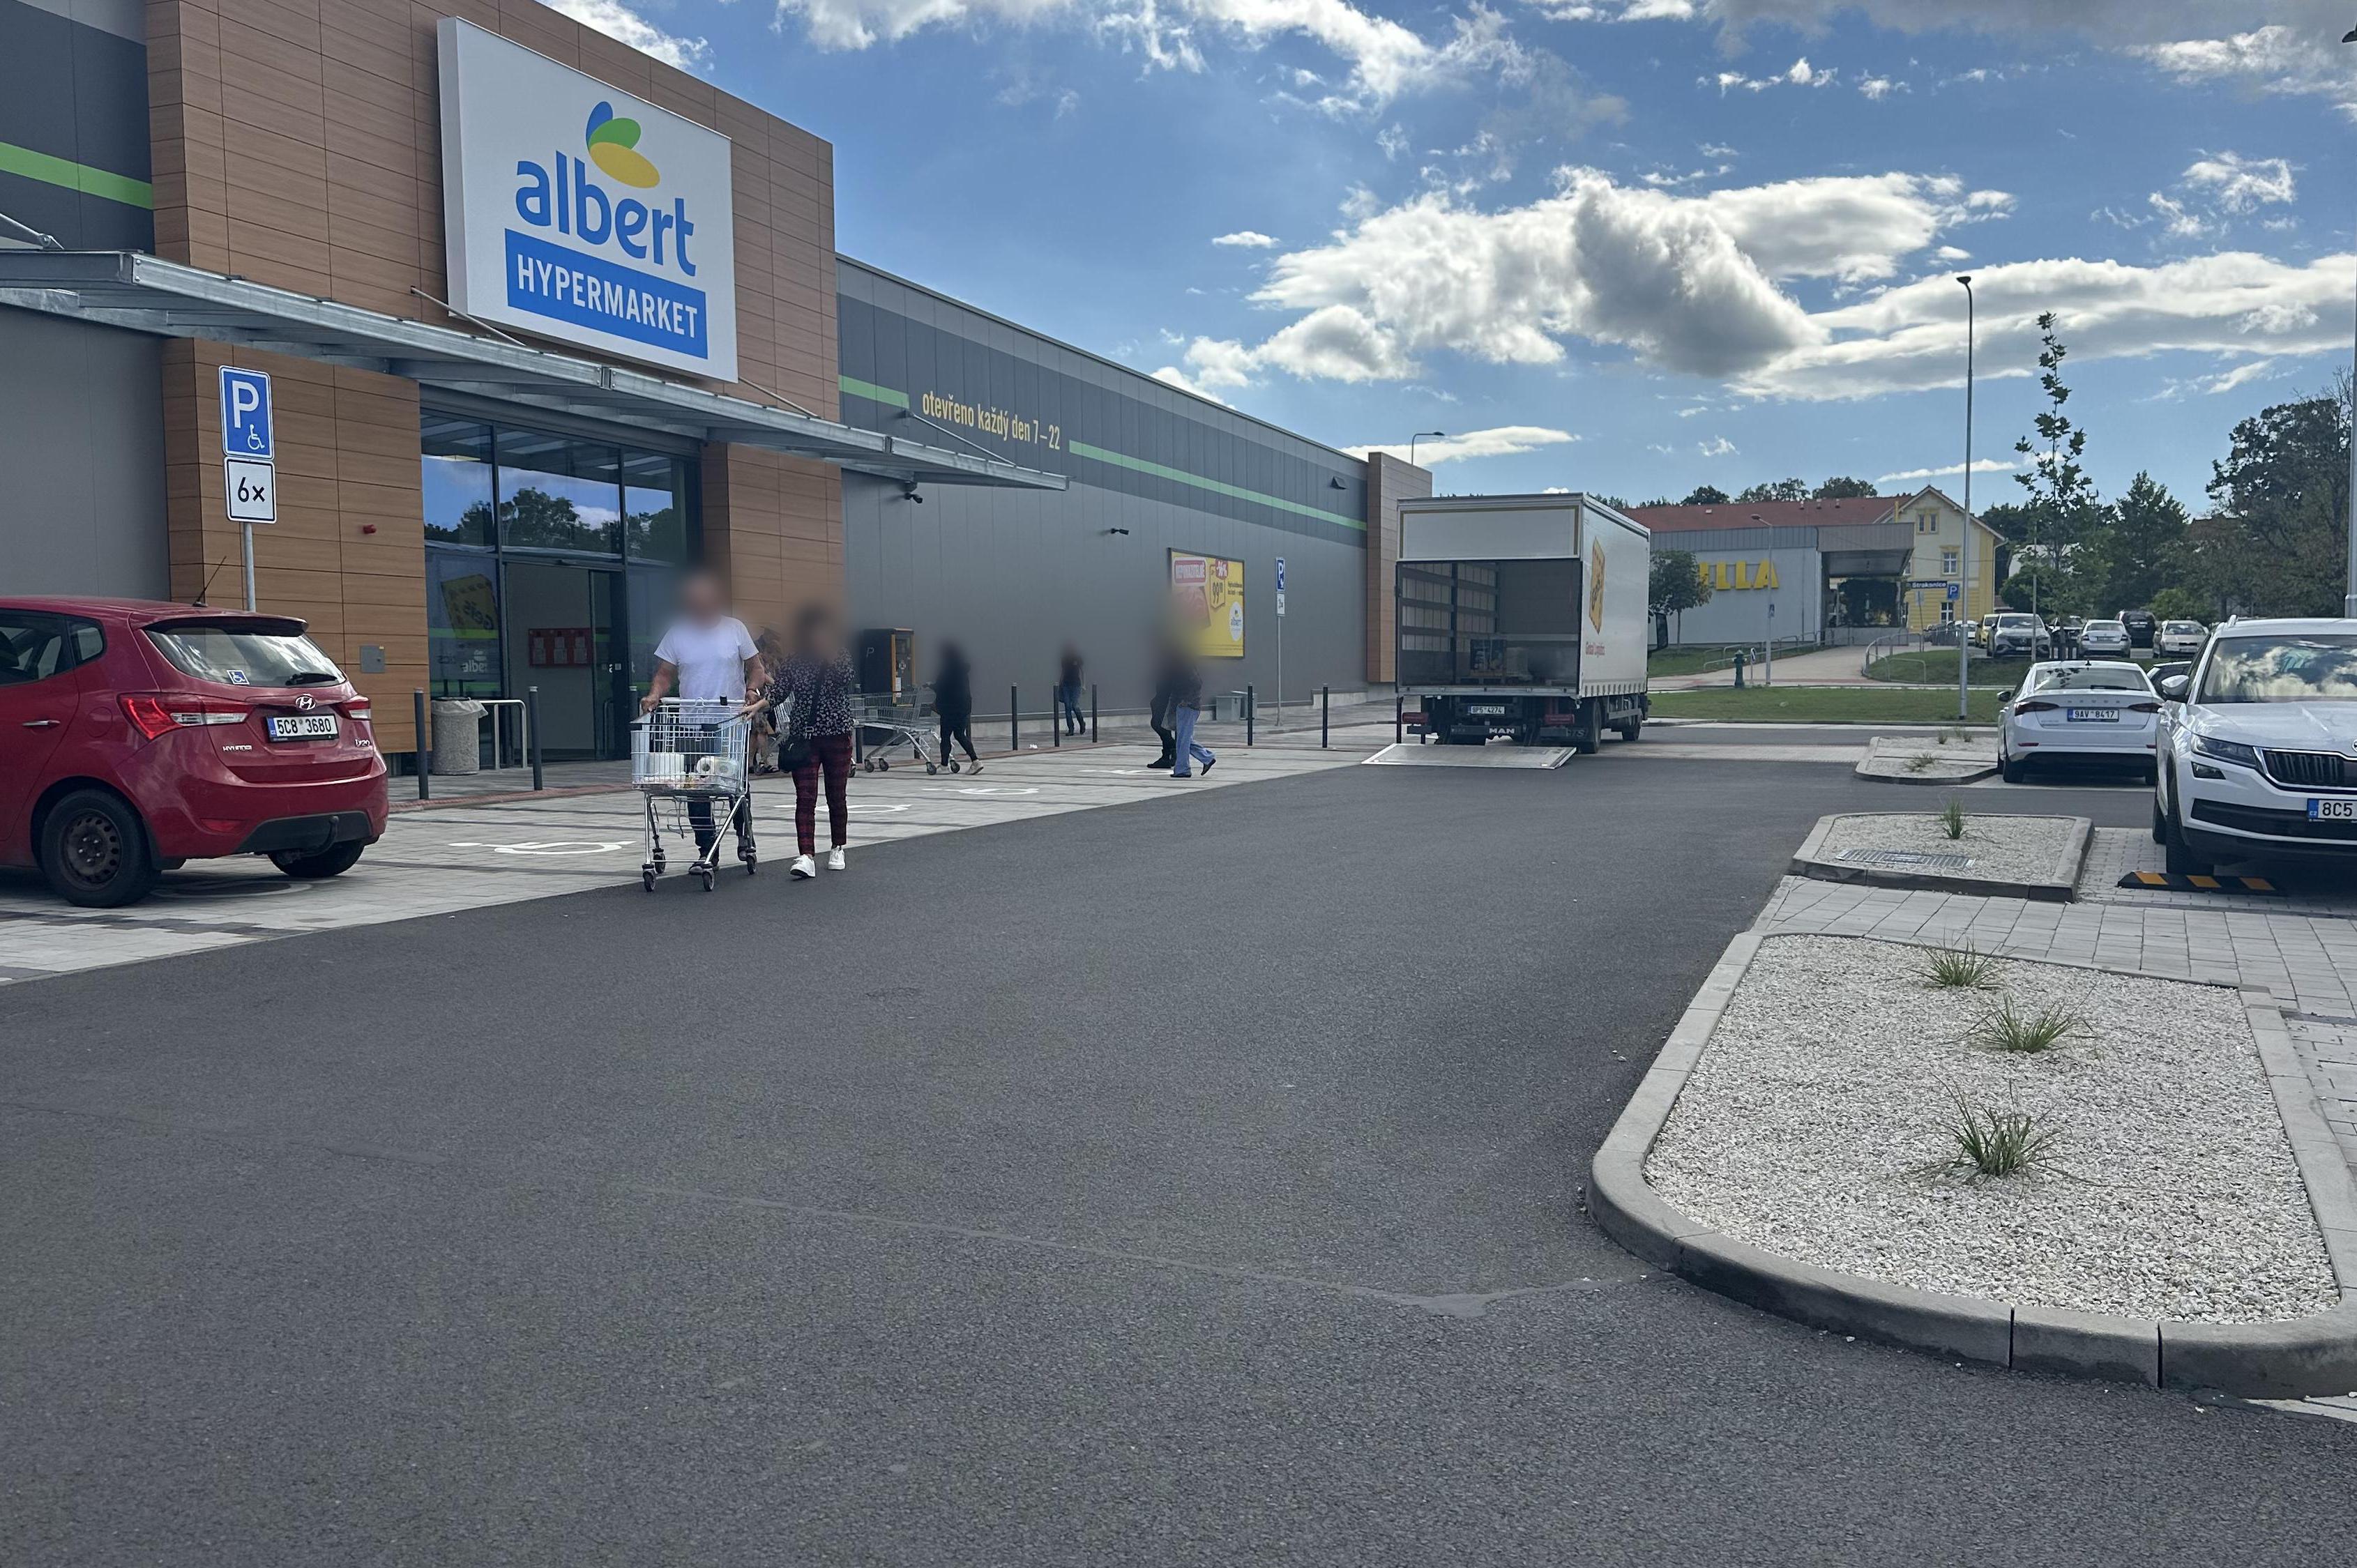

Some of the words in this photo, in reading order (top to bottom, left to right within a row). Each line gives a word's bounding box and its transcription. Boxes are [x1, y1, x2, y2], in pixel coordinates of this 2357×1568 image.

[515, 150, 697, 277] albert
[517, 254, 697, 340] HYPERMARKET
[232, 379, 260, 429] P
[922, 390, 975, 427] otevřeno
[978, 403, 1009, 441] každý
[1012, 414, 1031, 443] den
[237, 476, 265, 503] 6x
[1699, 559, 1779, 591] ILLA
[1949, 586, 1958, 595] P
[277, 719, 298, 734] 5C8
[305, 717, 332, 733] 3680
[2074, 710, 2089, 718] 9AV
[2095, 710, 2115, 718] 8417
[2322, 802, 2354, 816] 8C5
